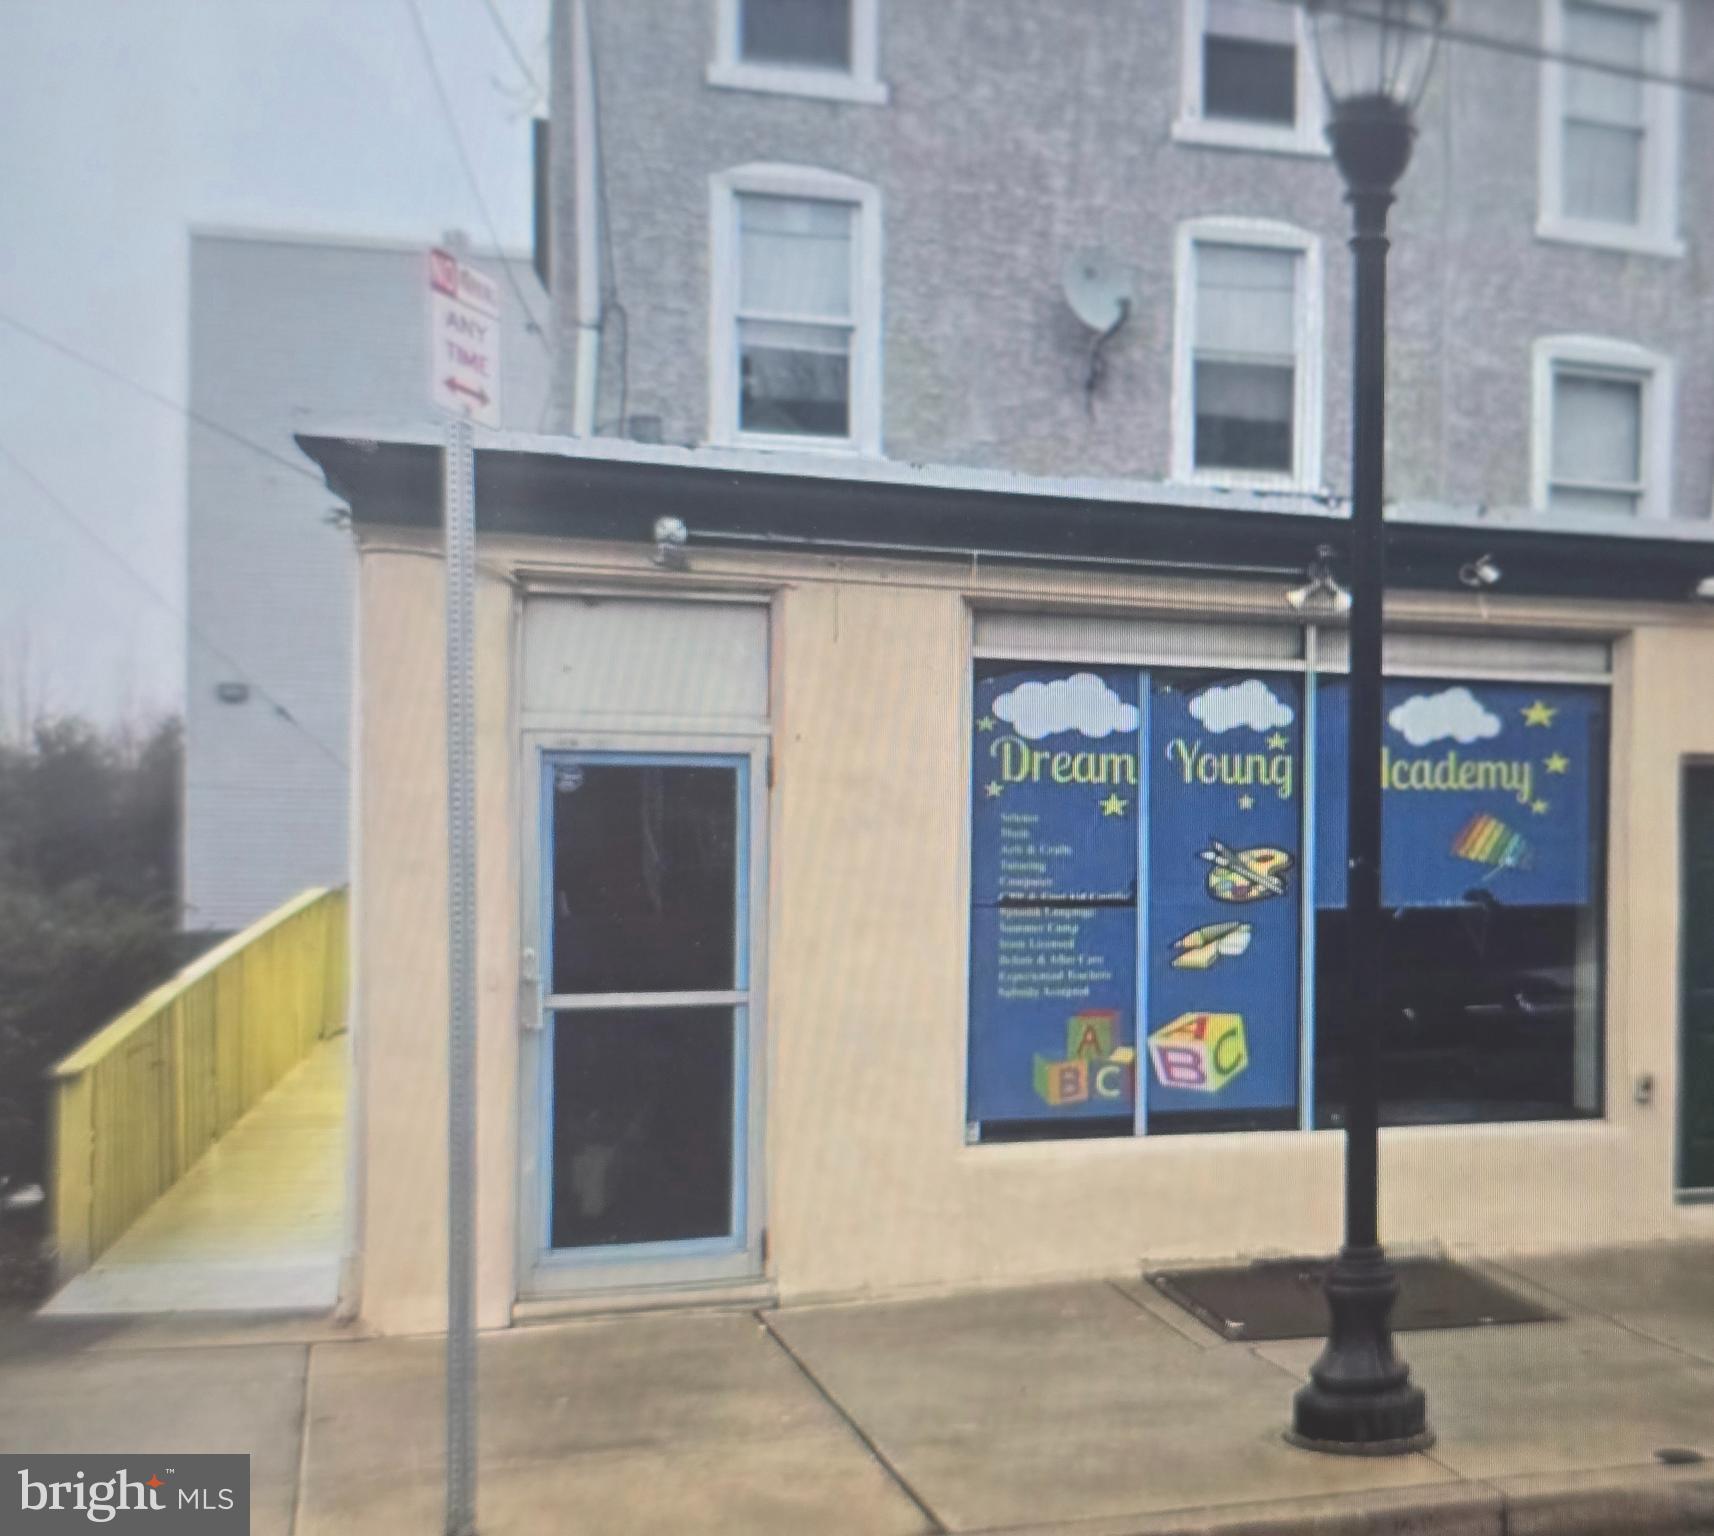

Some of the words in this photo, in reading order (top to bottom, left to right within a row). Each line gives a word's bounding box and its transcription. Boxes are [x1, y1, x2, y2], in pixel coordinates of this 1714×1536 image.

[446, 309, 488, 342] ANY
[446, 339, 491, 378] TIME
[990, 735, 1138, 786] Dream
[1165, 737, 1293, 800] Young
